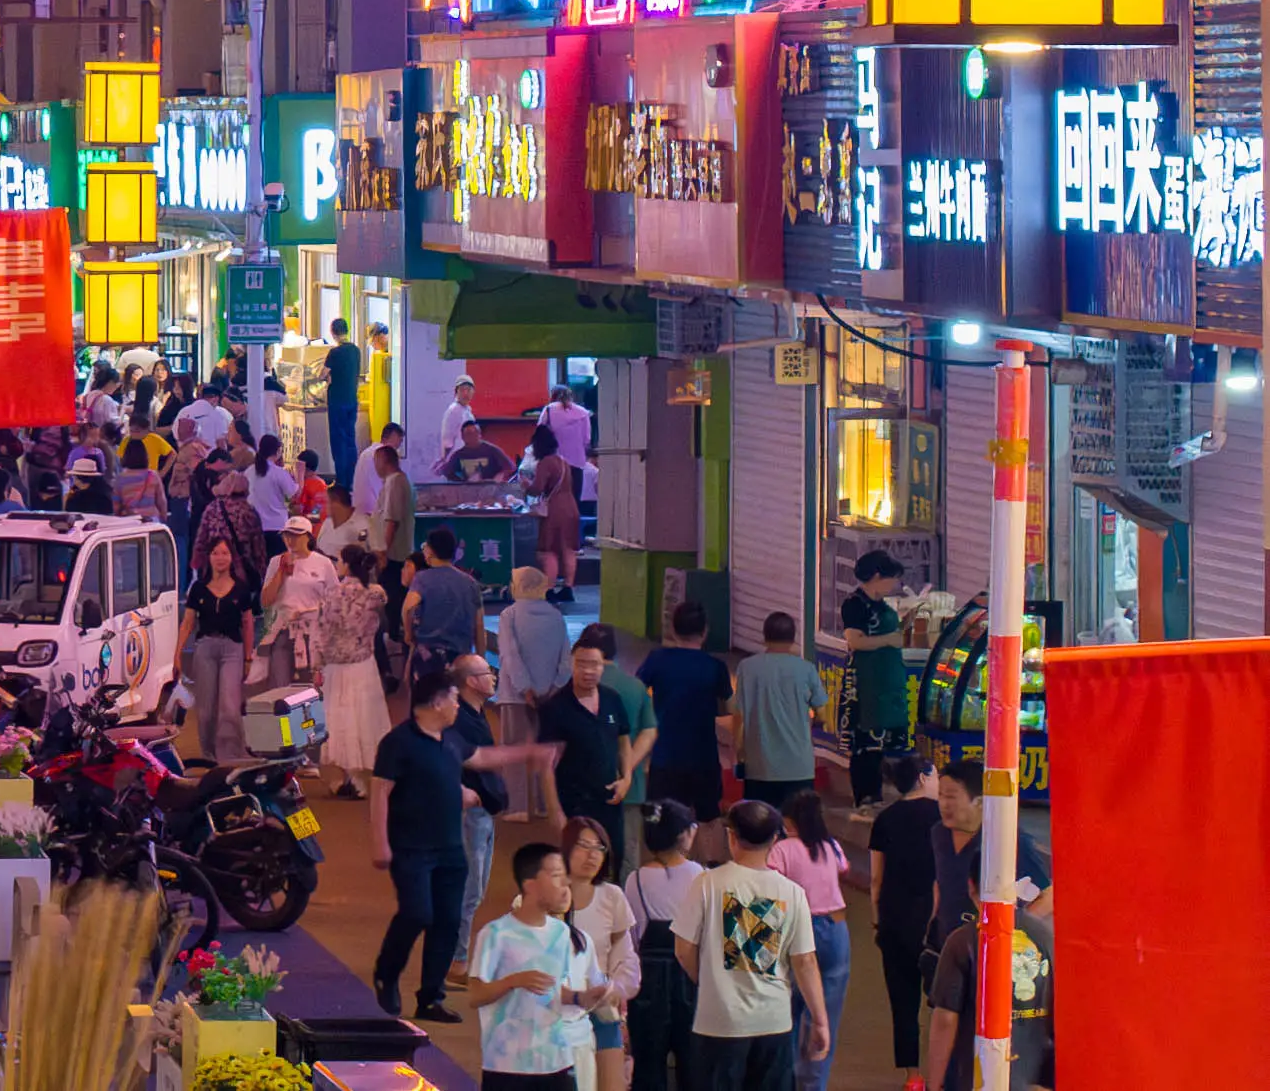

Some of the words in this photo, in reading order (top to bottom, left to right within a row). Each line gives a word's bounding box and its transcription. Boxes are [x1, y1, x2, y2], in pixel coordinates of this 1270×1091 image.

[908, 158, 988, 242] 兰州牛肉面
